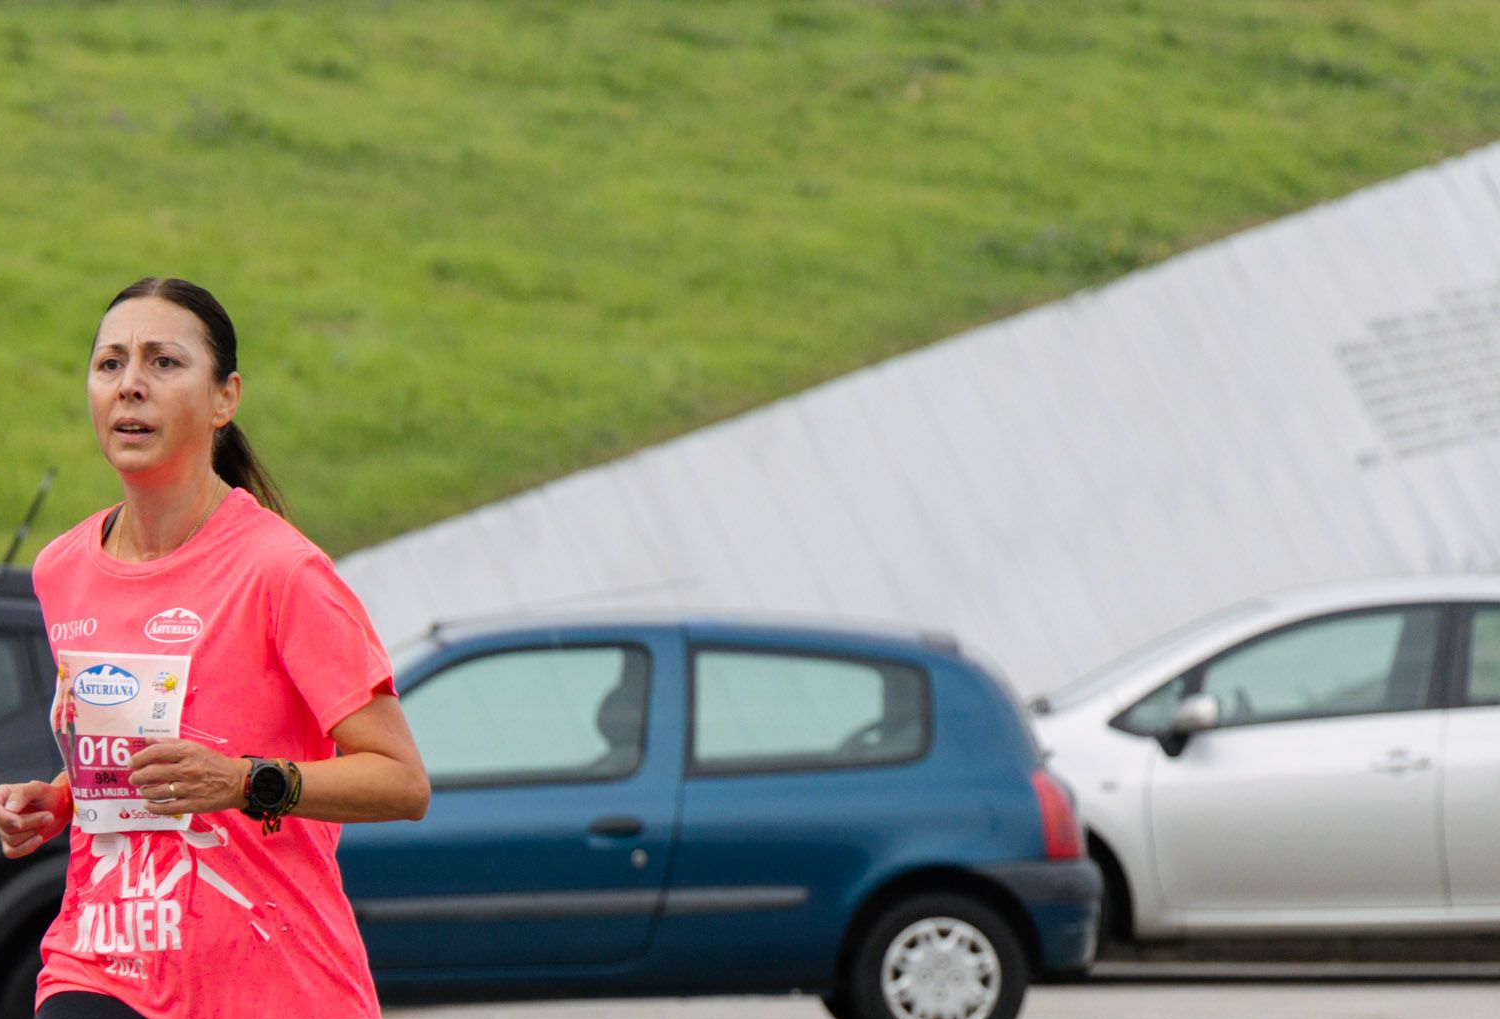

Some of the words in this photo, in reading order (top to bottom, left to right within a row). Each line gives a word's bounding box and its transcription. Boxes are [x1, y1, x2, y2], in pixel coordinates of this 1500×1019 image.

[51, 618, 97, 642] OYSHO
[149, 621, 197, 635] ASTURIANA
[77, 679, 133, 696] ASTURIANA
[78, 736, 131, 766] 016
[89, 788, 102, 798] LA
[102, 788, 130, 797] MUJER
[73, 900, 182, 953] MUJER
